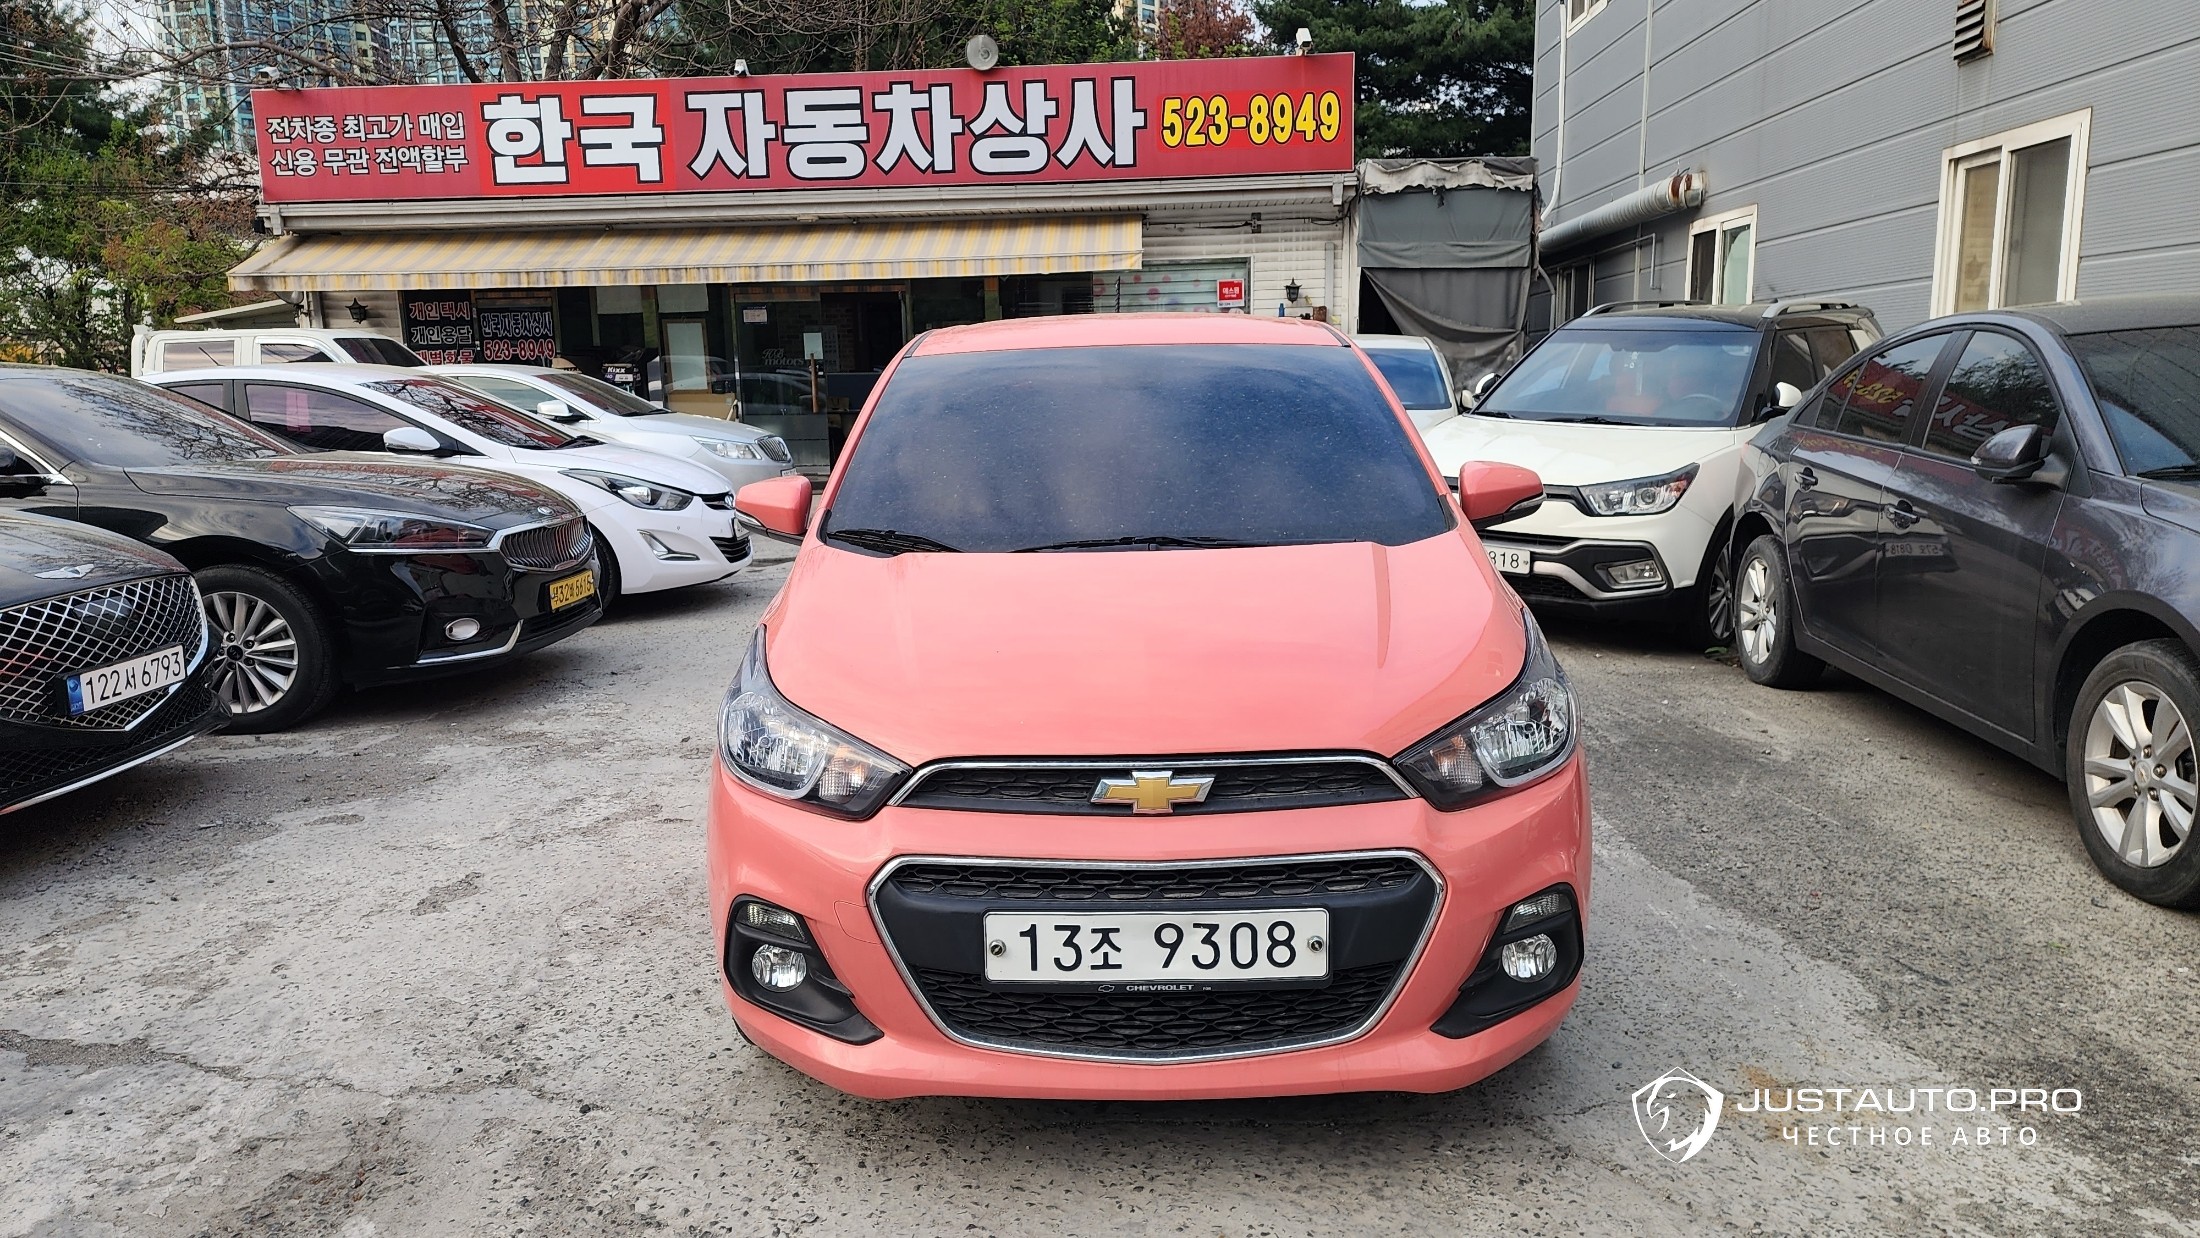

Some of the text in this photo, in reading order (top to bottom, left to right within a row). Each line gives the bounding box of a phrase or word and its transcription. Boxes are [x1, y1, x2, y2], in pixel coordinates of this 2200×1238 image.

[266, 112, 466, 144] 전차종 최고가 매입
[481, 75, 1148, 186] 한국 자동차상사
[1159, 89, 1342, 149] 523-8949
[269, 145, 469, 176] 신용 무관 전액할부
[409, 301, 471, 321] 개인택시
[480, 311, 553, 338] 한국자동차상사
[411, 325, 472, 345] 개인용달
[483, 339, 556, 361] 523-8949
[607, 366, 626, 374] Kixx
[86, 651, 181, 704] 122서 6793
[1019, 920, 1297, 972] 13조 9308
[1126, 984, 1194, 992] CHEVROLET
